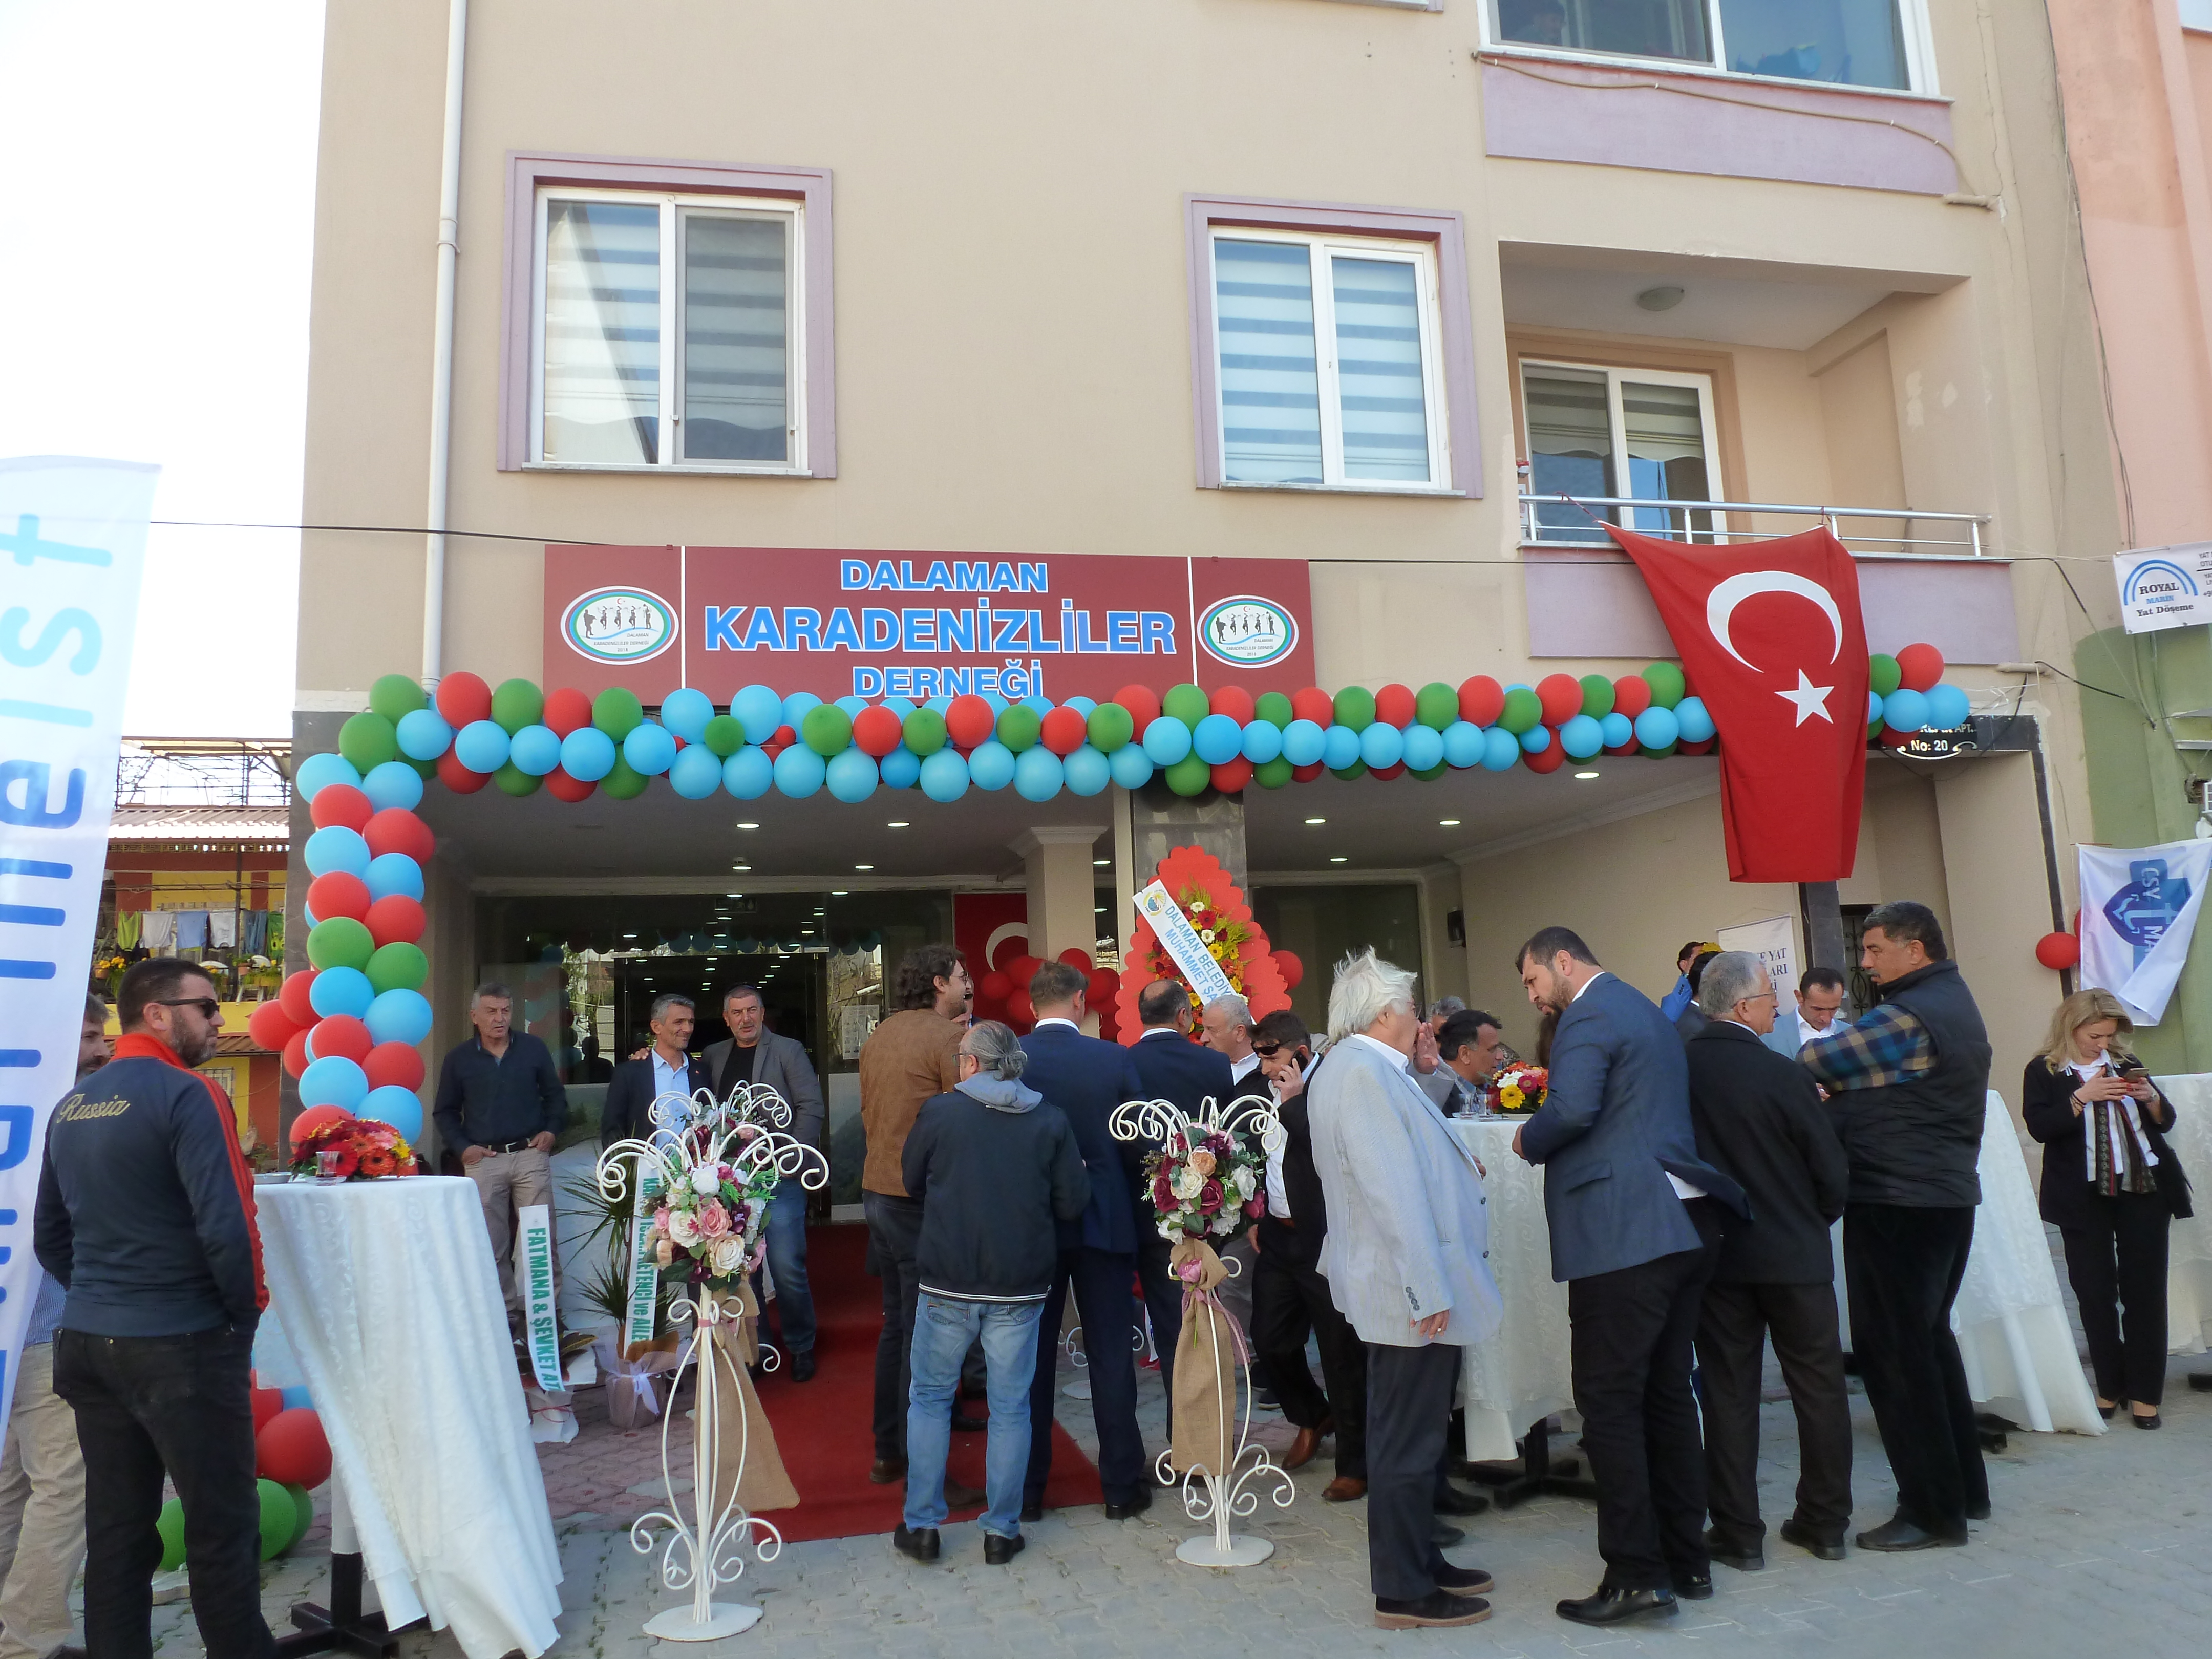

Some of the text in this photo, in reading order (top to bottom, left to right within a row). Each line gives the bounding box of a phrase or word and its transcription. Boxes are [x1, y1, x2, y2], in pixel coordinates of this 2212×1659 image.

[841, 559, 1048, 593] DALAMAN
[2139, 582, 2179, 594] ROYAL
[705, 597, 1177, 654] KARADENİZLİLER
[2136, 604, 2194, 616] Yat Döşeme
[853, 659, 1042, 698] DERNEĞİ
[1911, 740, 1948, 751] No: 20
[2141, 867, 2161, 900] CSY
[1165, 905, 1233, 995] DALAMAN BELEDİY
[1165, 928, 1218, 1001] MUHAMMET ŞA
[1768, 948, 1787, 961] YAT
[56, 1094, 131, 1123] Russia
[527, 1227, 562, 1391] FATMANA & ŞEVKET AT
[633, 1303, 649, 1316] ve
[630, 1318, 654, 1344] AİLE
